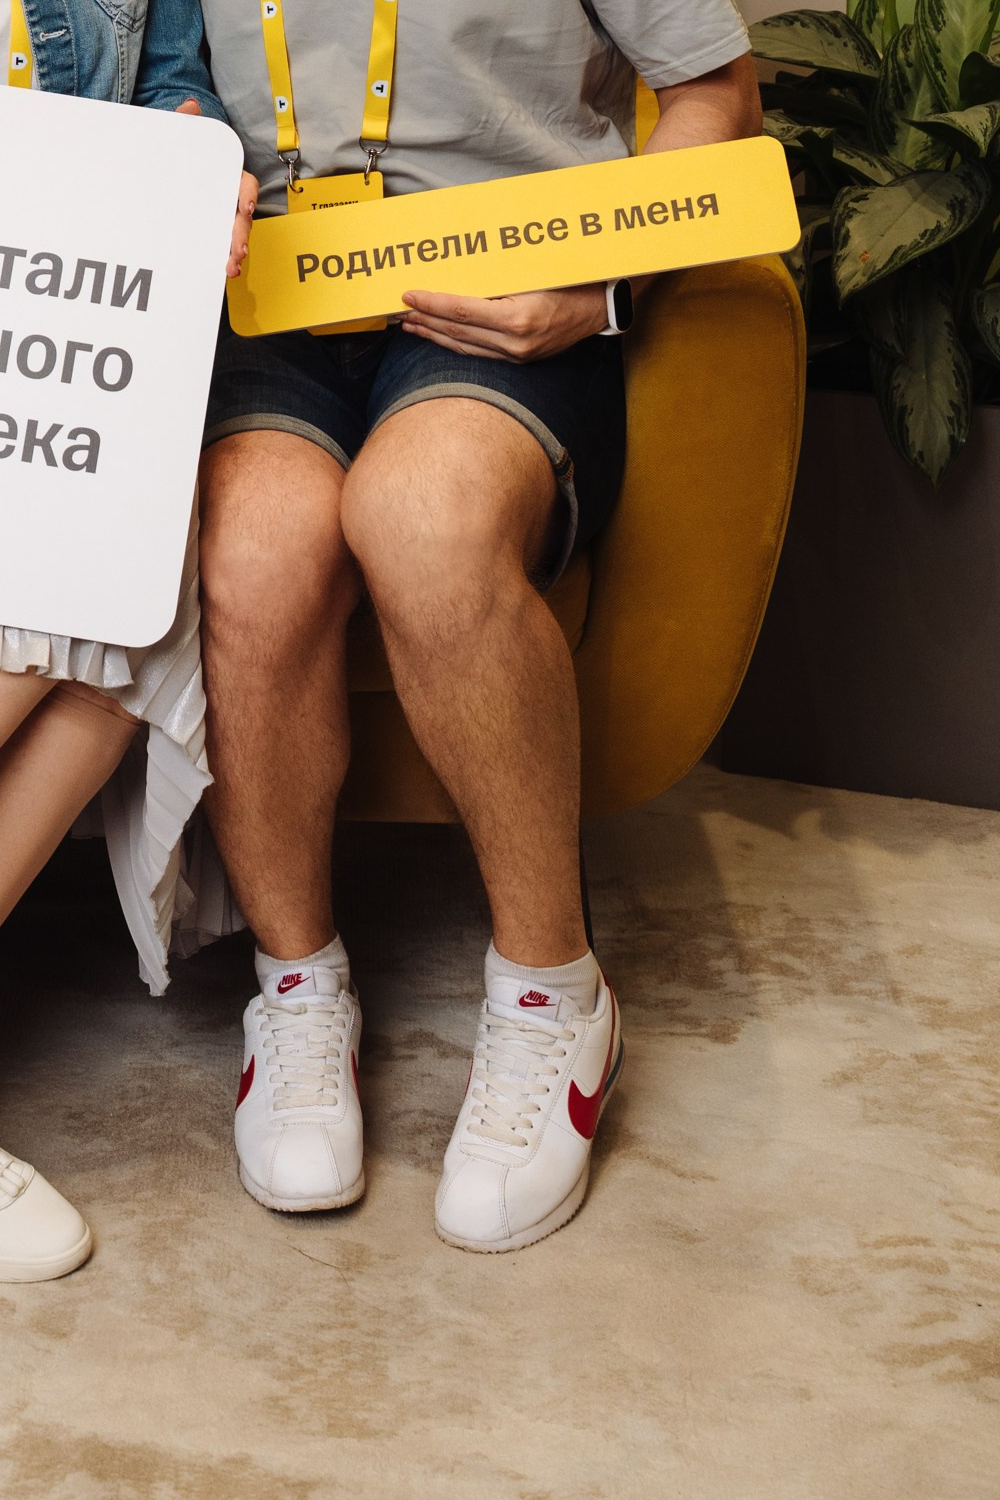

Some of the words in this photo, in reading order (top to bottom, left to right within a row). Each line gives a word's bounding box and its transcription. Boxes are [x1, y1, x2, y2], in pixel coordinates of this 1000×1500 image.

[296, 230, 488, 284] Родители
[499, 217, 569, 250] все
[579, 212, 603, 237] в
[614, 193, 720, 232] меня
[281, 972, 303, 986] NIKE
[525, 989, 550, 1005] NIKE
